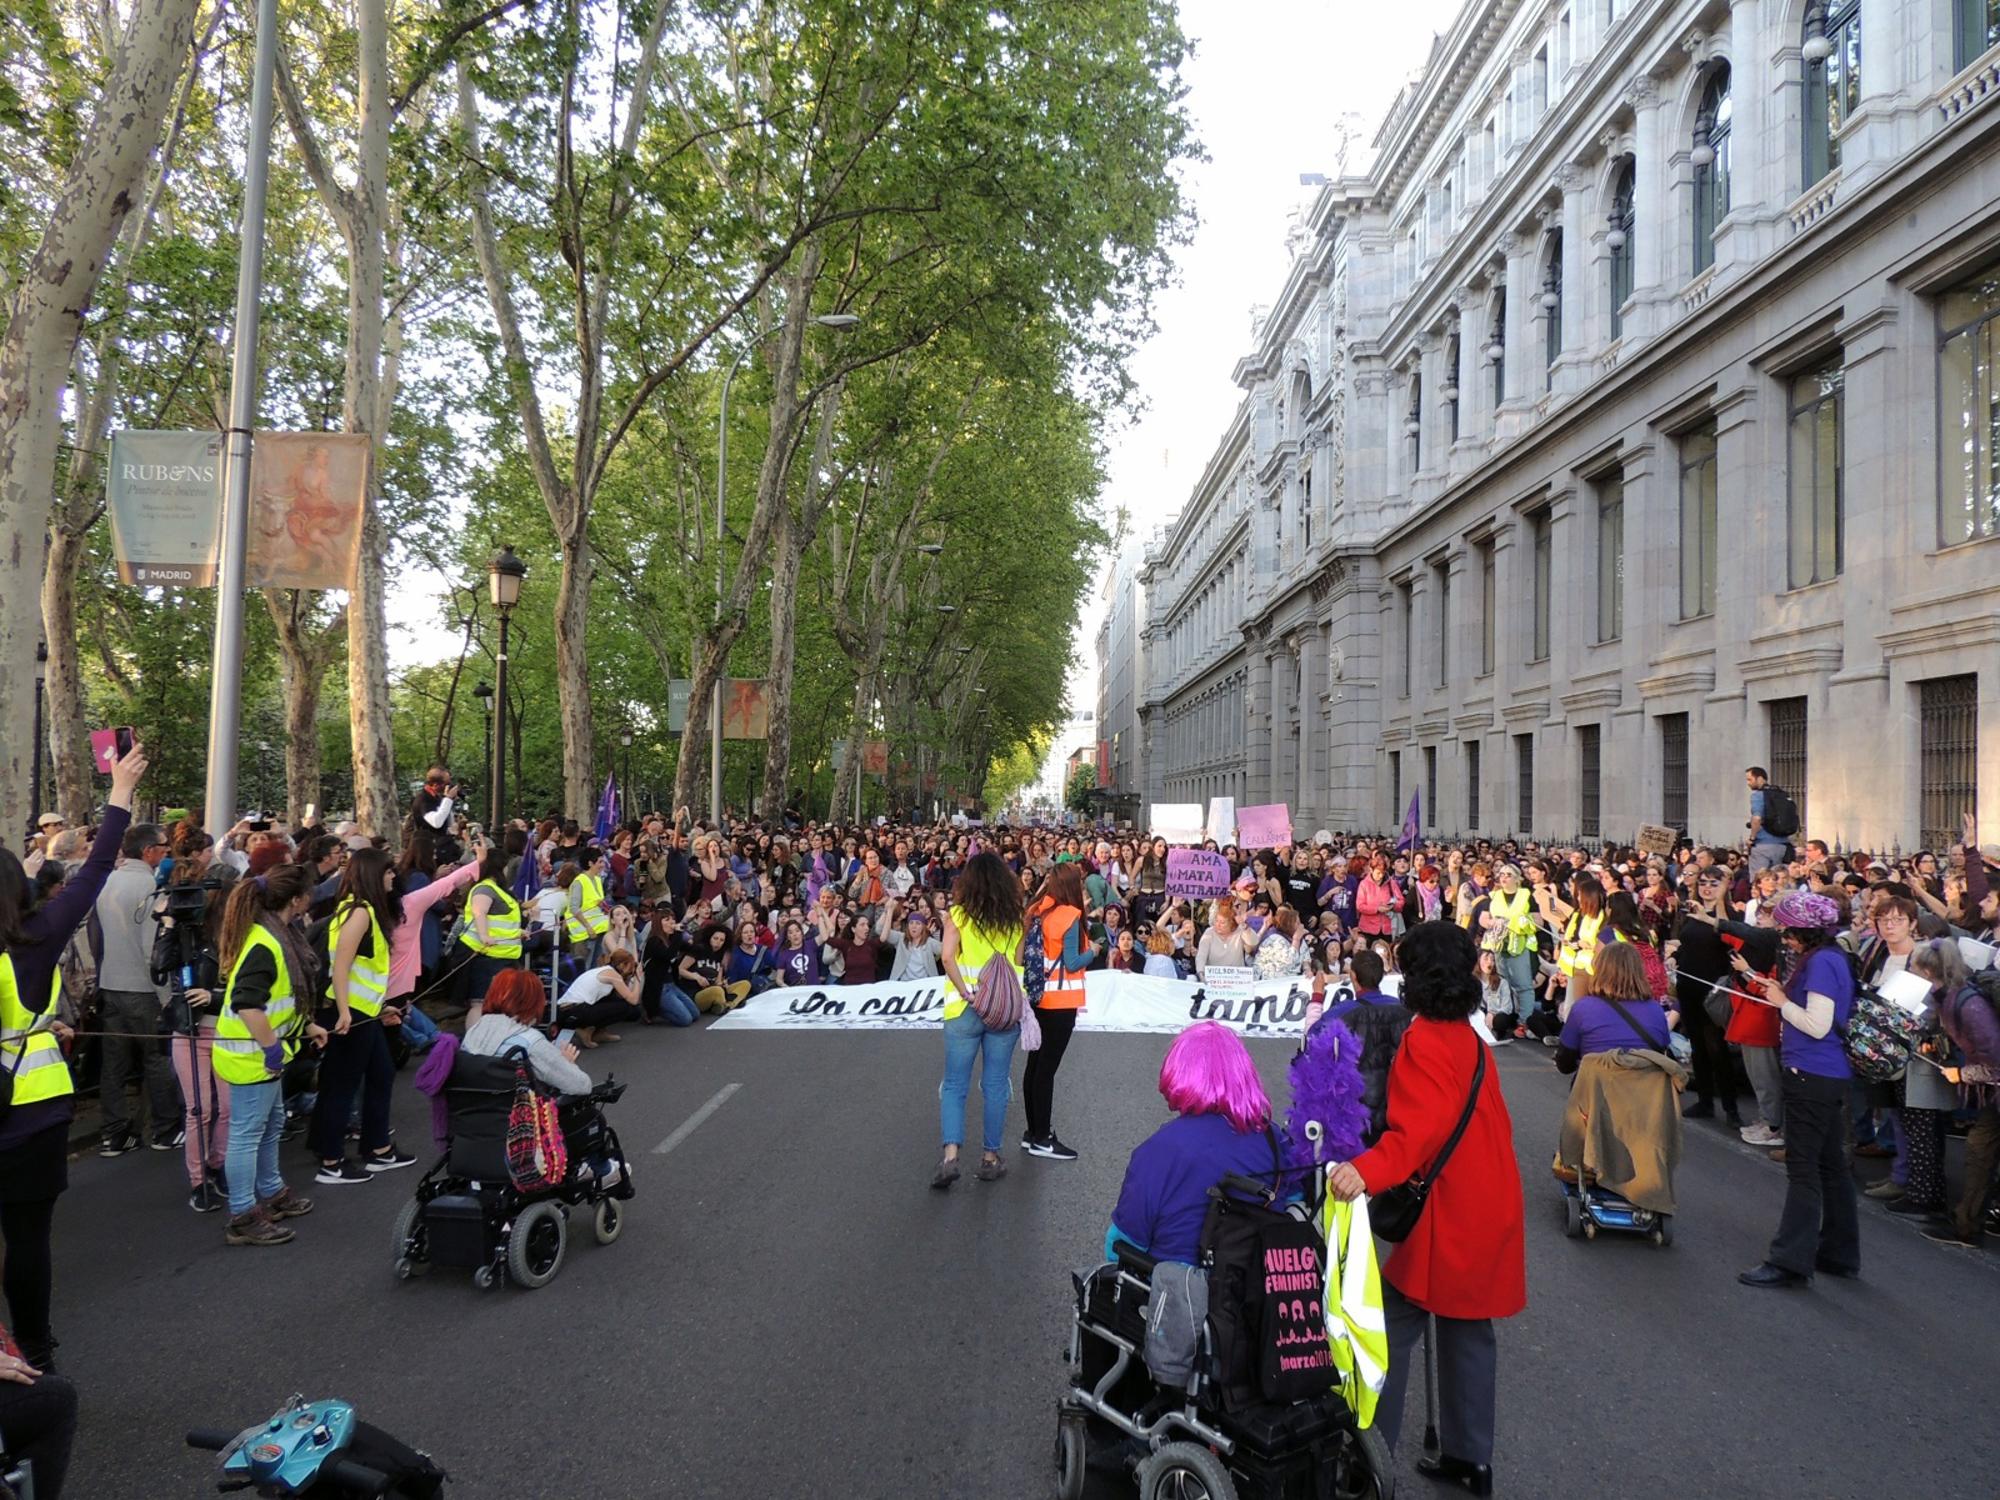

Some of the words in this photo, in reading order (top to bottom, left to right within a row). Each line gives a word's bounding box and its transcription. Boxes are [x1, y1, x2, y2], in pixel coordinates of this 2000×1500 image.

[150, 570, 192, 580] MADRID
[1191, 853, 1222, 866] AMA
[1178, 869, 1214, 882] MATA
[1166, 884, 1228, 896] MALTRATA
[1265, 1246, 1316, 1273] HUELG
[1265, 1272, 1320, 1294] FEMINIST
